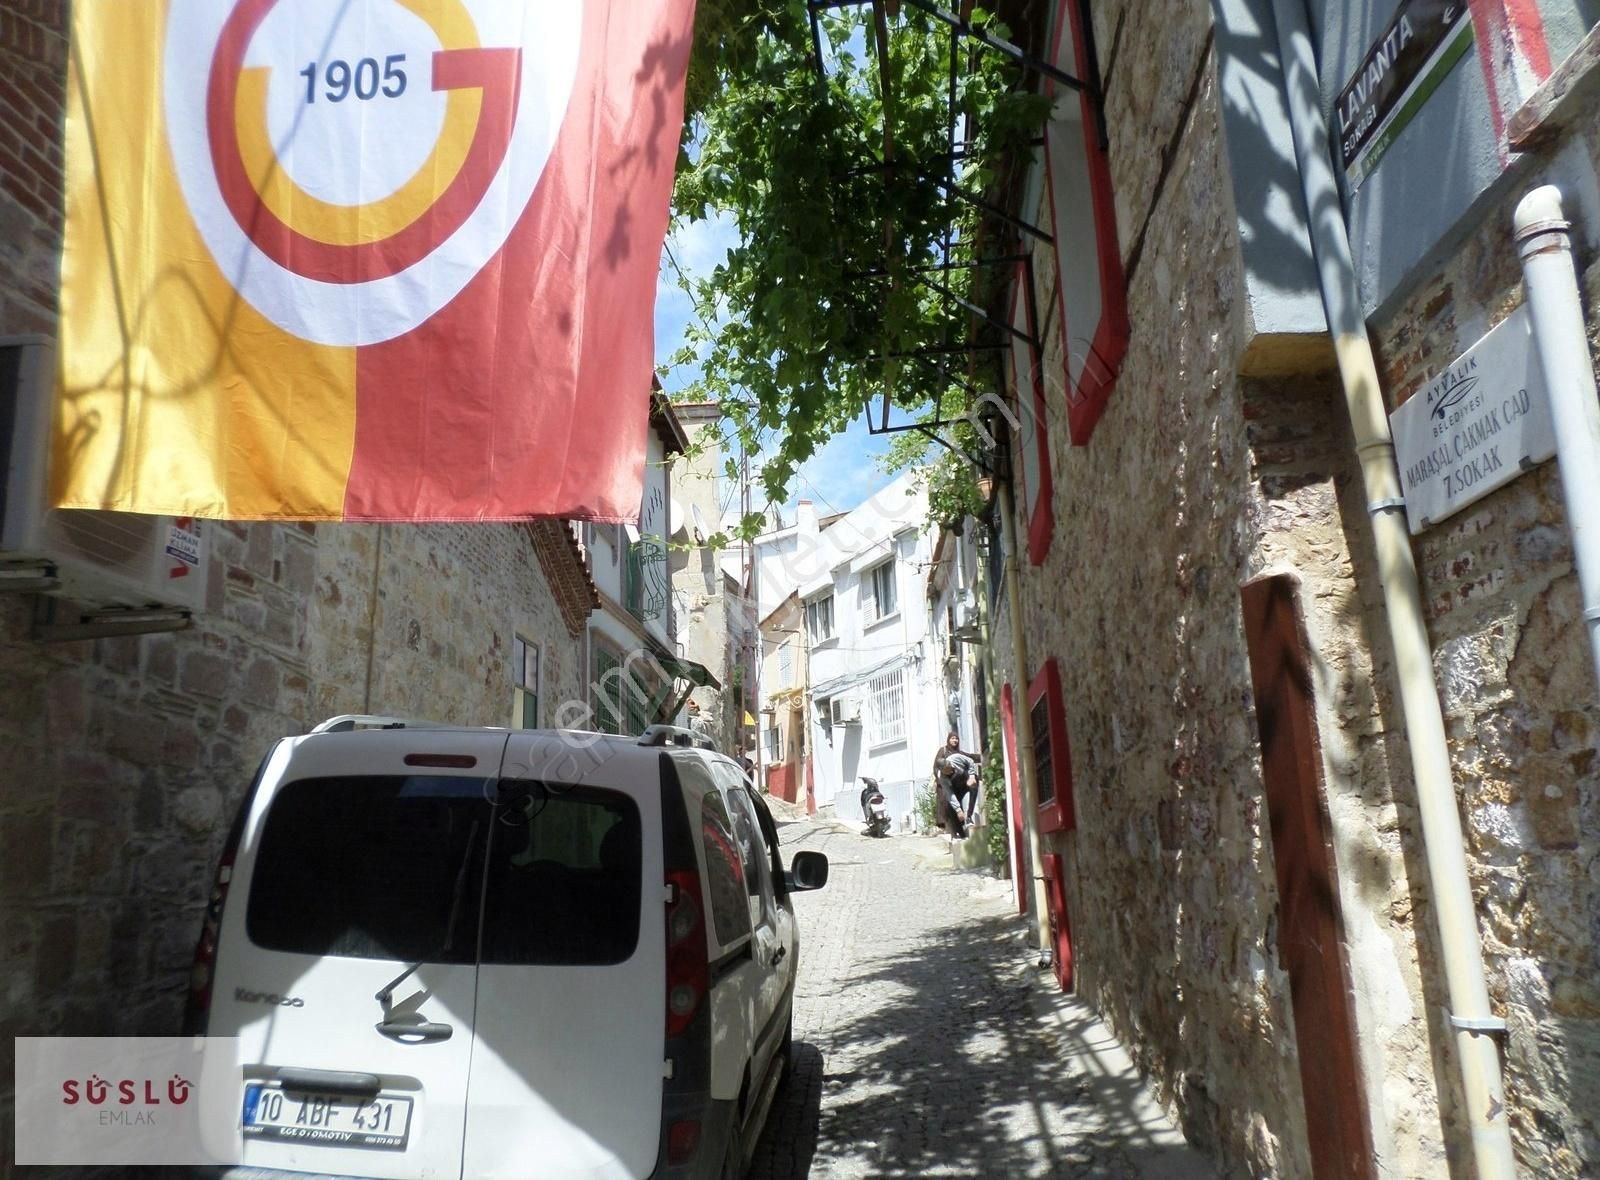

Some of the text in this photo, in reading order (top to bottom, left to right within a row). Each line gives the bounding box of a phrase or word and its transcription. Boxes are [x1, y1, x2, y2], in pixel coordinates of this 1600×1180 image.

[300, 53, 408, 105] 1905
[1338, 14, 1414, 133] LAVANTA
[1427, 356, 1478, 404] AYVALIK
[1453, 407, 1502, 461] ÇAKMAK
[1503, 388, 1530, 424] CAD
[261, 1093, 283, 1121] 10
[296, 1095, 342, 1127] ABF
[352, 1098, 393, 1132] 431
[280, 1127, 297, 1136] EGE
